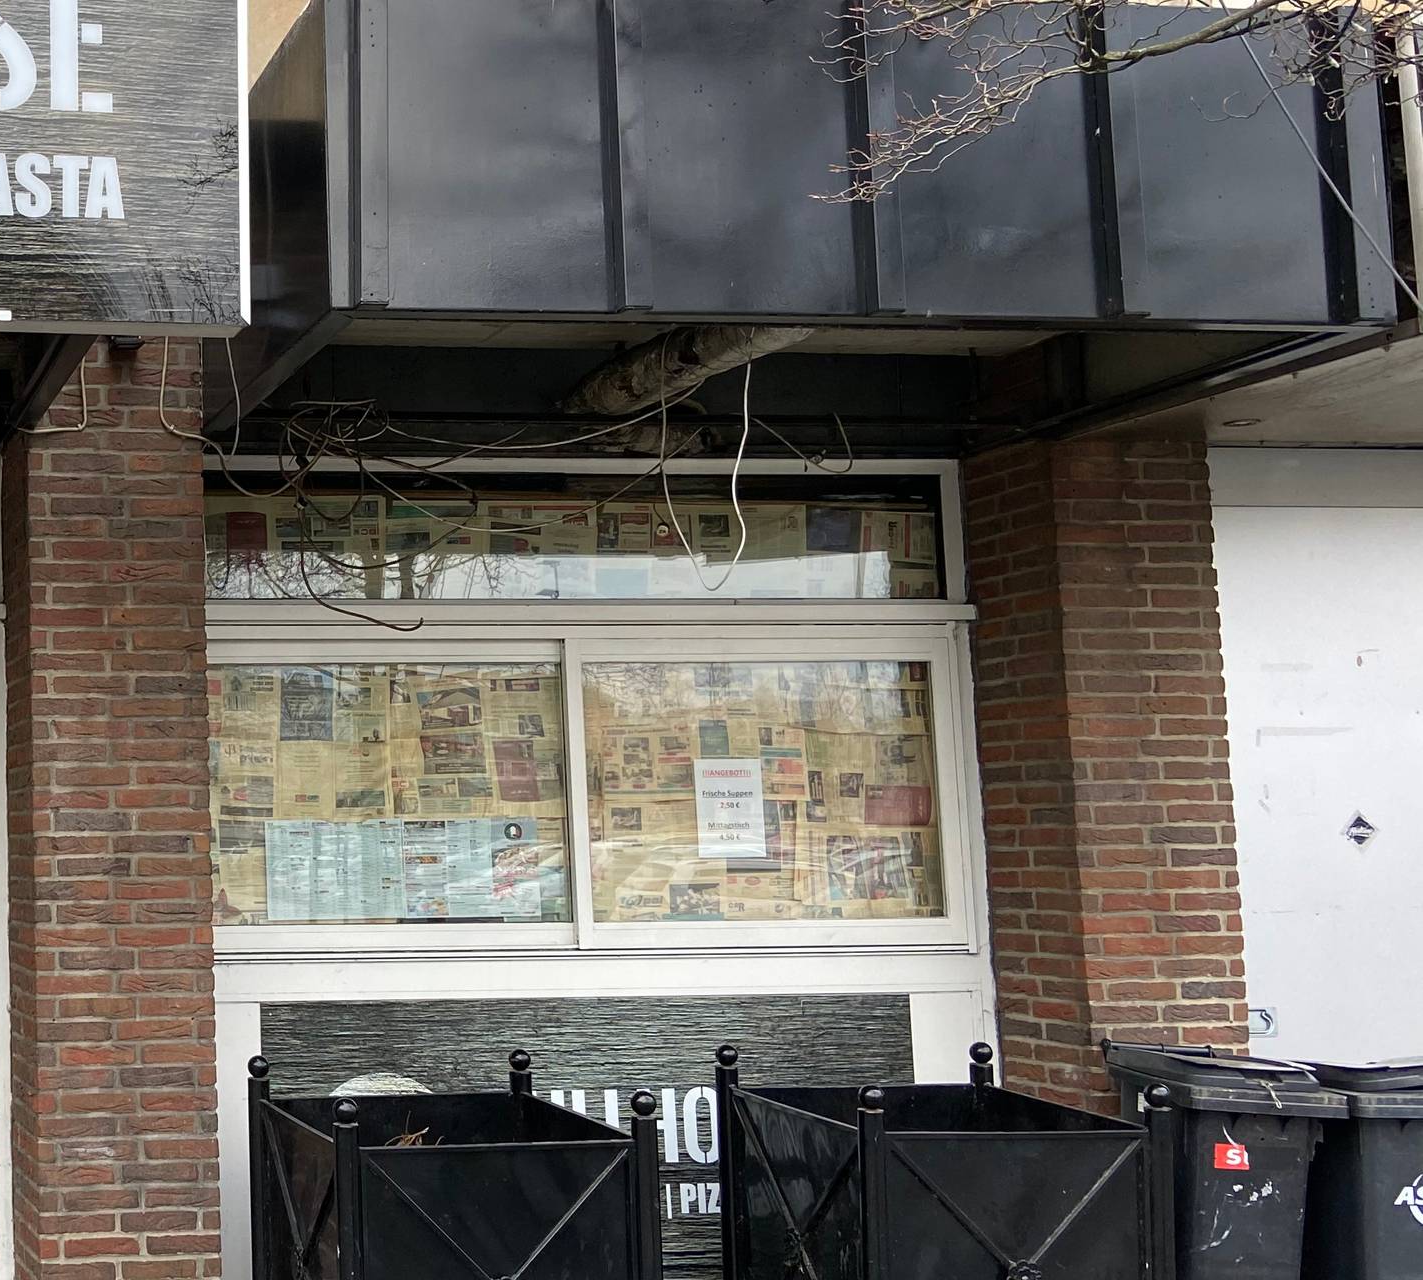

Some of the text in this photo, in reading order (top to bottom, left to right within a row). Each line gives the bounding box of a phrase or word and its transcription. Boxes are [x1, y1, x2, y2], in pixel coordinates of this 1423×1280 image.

[702, 789, 753, 798] Frische Suppen
[679, 1182, 722, 1214] PIZ
